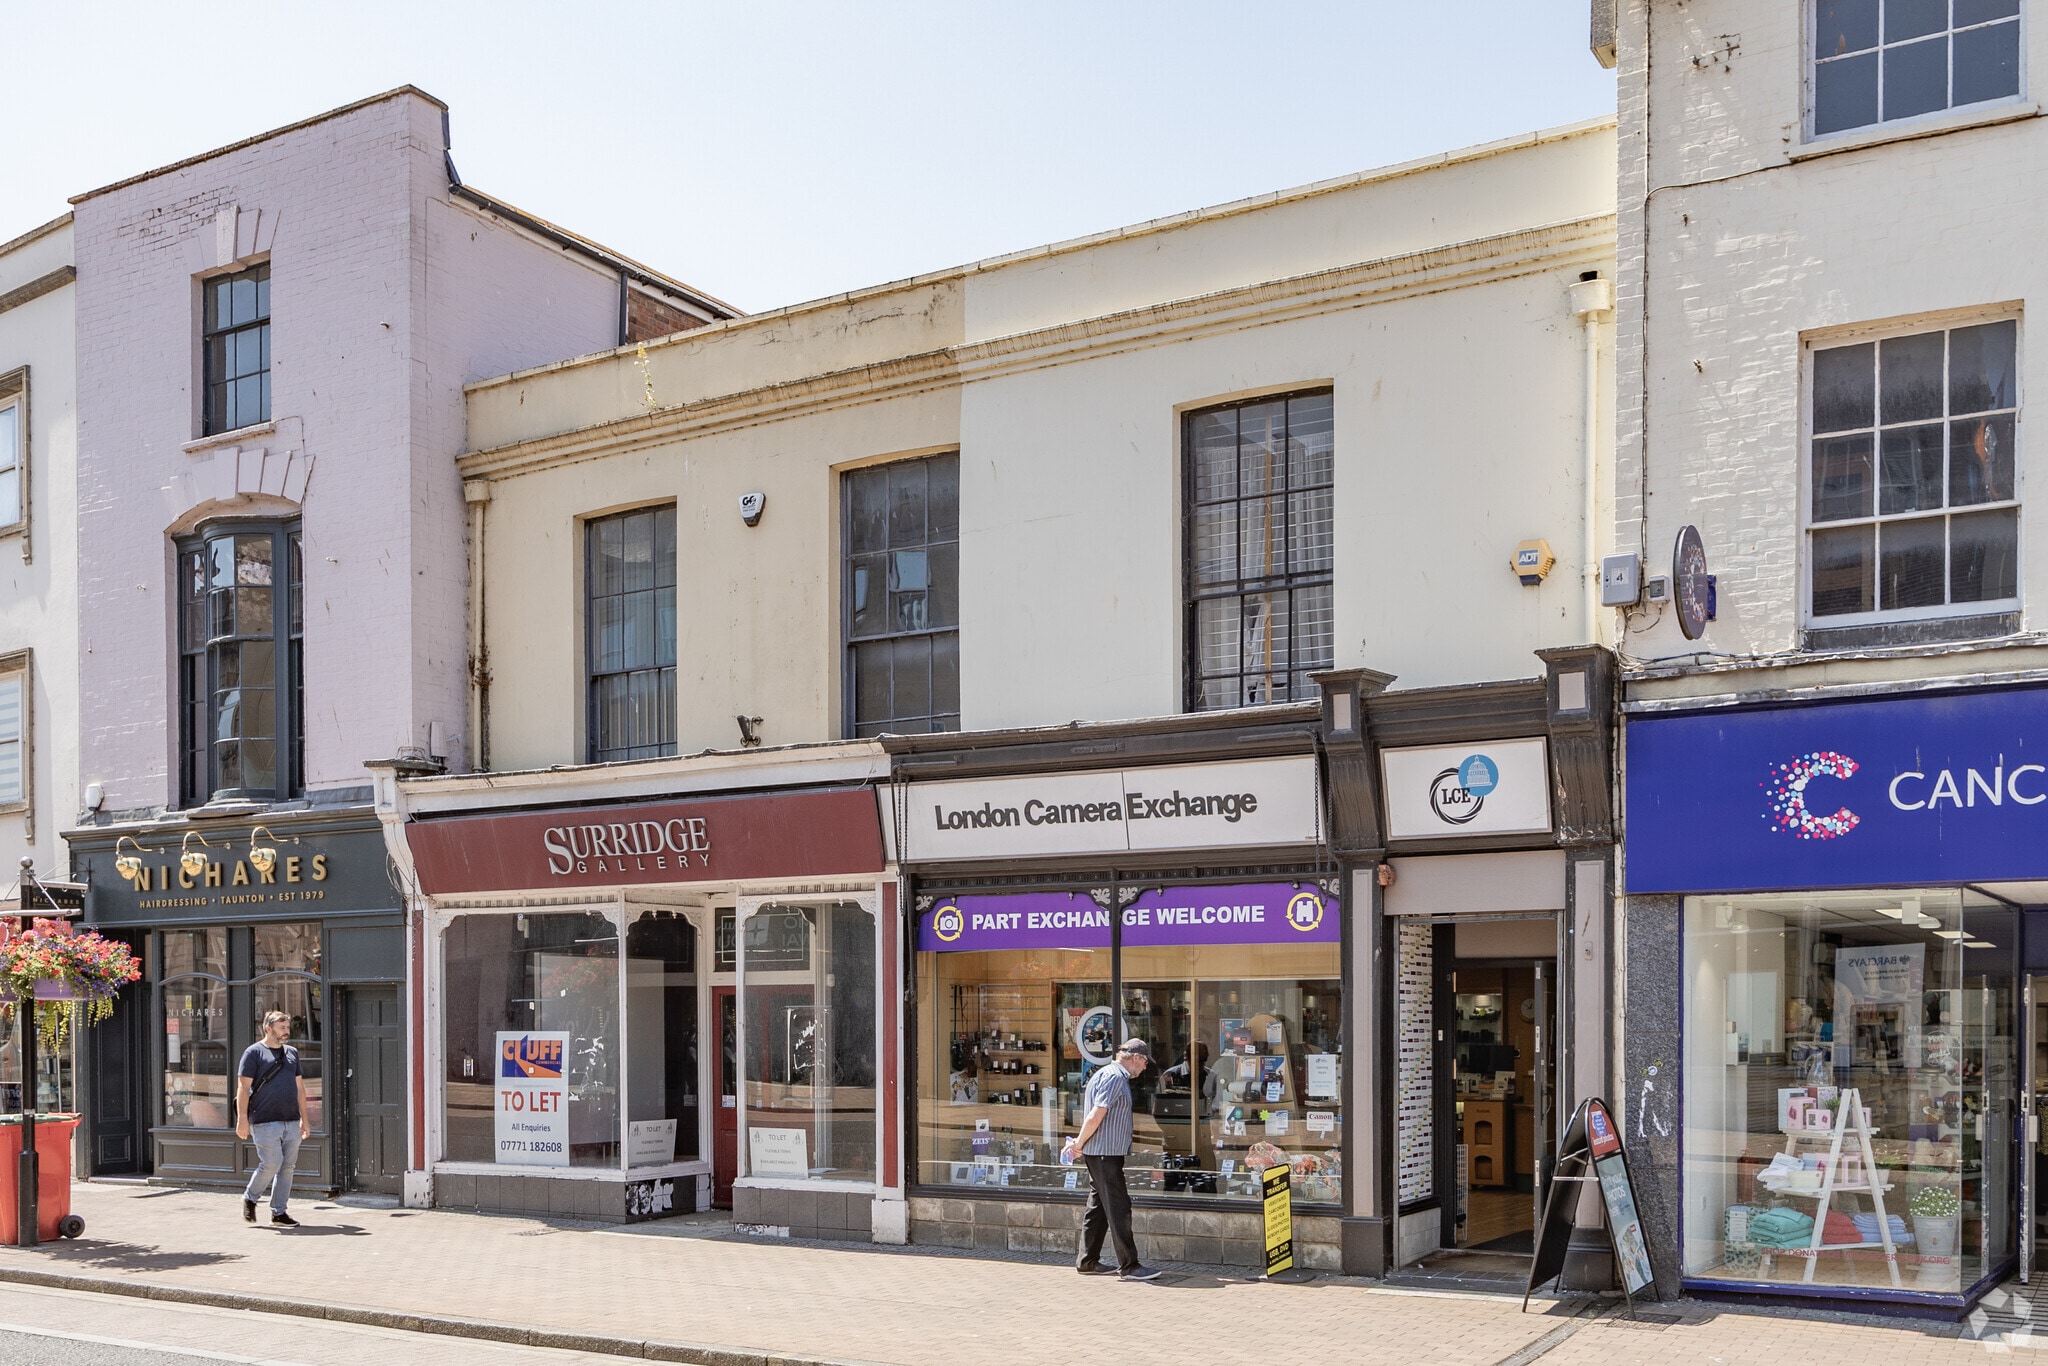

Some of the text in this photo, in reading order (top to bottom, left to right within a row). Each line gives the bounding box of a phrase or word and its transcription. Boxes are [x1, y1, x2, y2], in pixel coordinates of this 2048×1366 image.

[1518, 551, 1539, 564] ADT
[1615, 572, 1624, 582] 4
[1440, 787, 1471, 805] LCE
[1888, 764, 2047, 811] CANC
[934, 790, 1258, 830] London Camera Exchange
[543, 817, 712, 876] SURRIDGE
[576, 854, 710, 874] GALLERY
[32, 897, 80, 905] NICARES
[139, 890, 325, 909] HAIRDRESSING TAUNTON EST 1979
[972, 912, 1022, 930] PART
[1156, 905, 1265, 925] WELCOME
[168, 1008, 224, 1017] NICHARES
[503, 1039, 562, 1061] CLUFF
[501, 1091, 561, 1112] TO LET
[511, 1123, 551, 1133] All Enquiries
[768, 1133, 776, 1141] TO
[500, 1140, 562, 1152] 07771 182608
[1266, 1181, 1288, 1197] TRANSFER
[1272, 1176, 1281, 1186] WE
